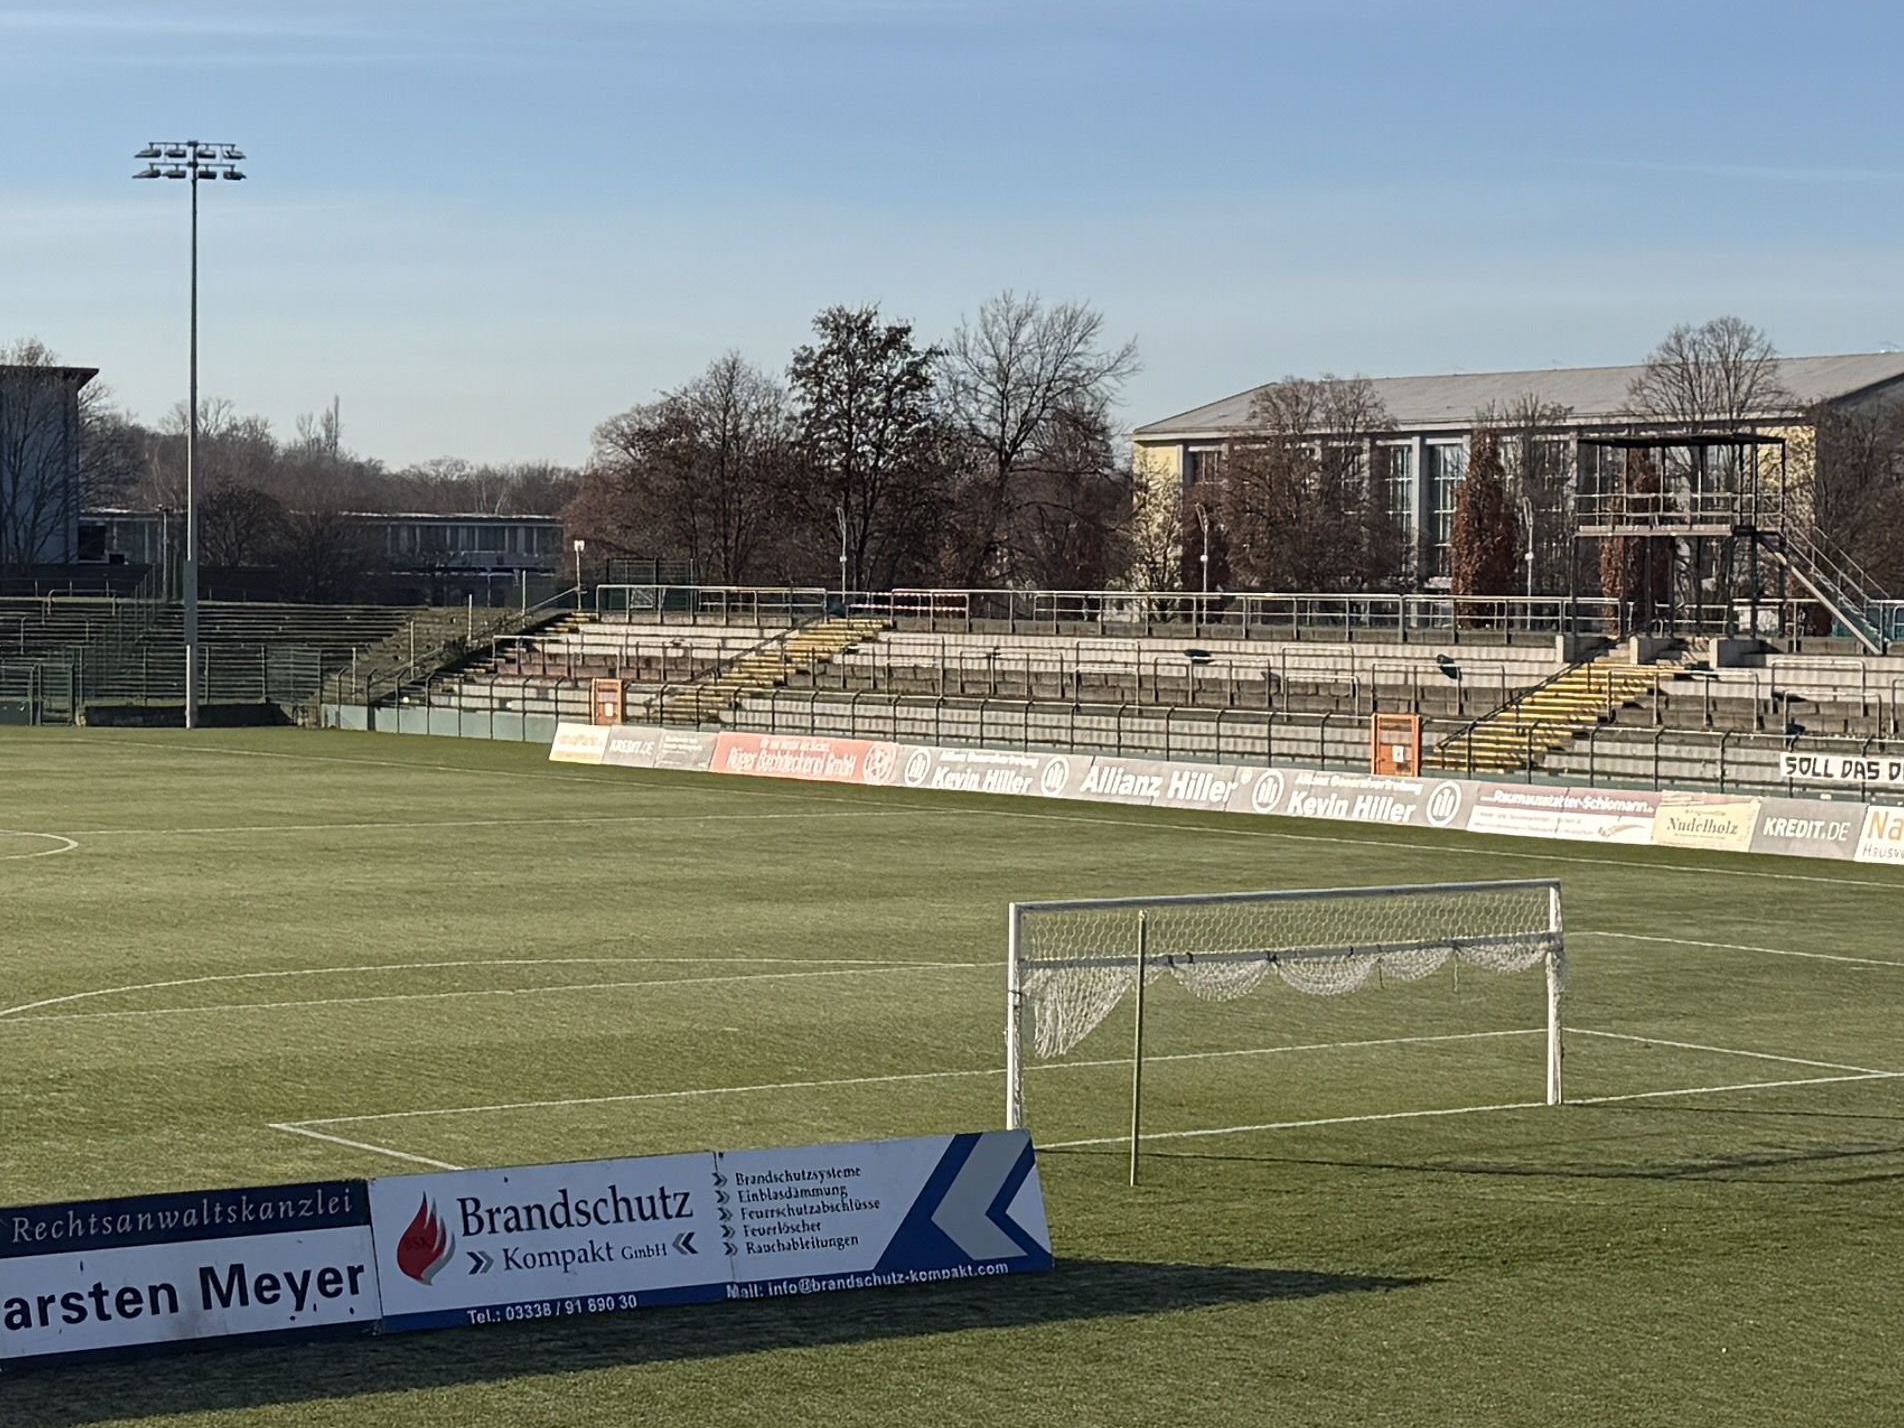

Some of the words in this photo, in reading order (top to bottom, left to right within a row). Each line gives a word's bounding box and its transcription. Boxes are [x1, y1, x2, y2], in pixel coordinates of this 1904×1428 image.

[931, 767, 981, 790] Kevin
[983, 769, 1034, 793] Hiller
[1785, 756, 1834, 778] SOLL
[1841, 760, 1880, 780] DAS
[1080, 766, 1162, 797] Allianz
[1167, 770, 1237, 803] Hiller
[1287, 791, 1349, 818] Kevin
[1351, 795, 1417, 823] Hiller
[1666, 815, 1740, 837] Nudelholz
[1763, 817, 1851, 841] KREDIT.DE
[734, 1165, 862, 1187] Brandschutzsysteme
[737, 1184, 849, 1204] Einblasdämmung
[11, 1187, 353, 1243] Rechtsanwaltskanzlei
[456, 1184, 694, 1238] Brandschutz
[740, 1197, 881, 1221] Feuerschutzabschlüsse
[743, 1220, 822, 1238] Feuerlöscher
[502, 1239, 615, 1273] Kompakt
[621, 1243, 669, 1261] GmbH
[745, 1233, 860, 1255] Rauchableitungen
[198, 1262, 365, 1312] Meyer
[725, 1282, 765, 1300] Mail:
[767, 1261, 1009, 1297] info@brandschutz-kompakt.com
[467, 1308, 502, 1325] Tel.:
[505, 1302, 552, 1322] 03338
[565, 1299, 583, 1315] 91
[618, 1294, 638, 1311] 30
